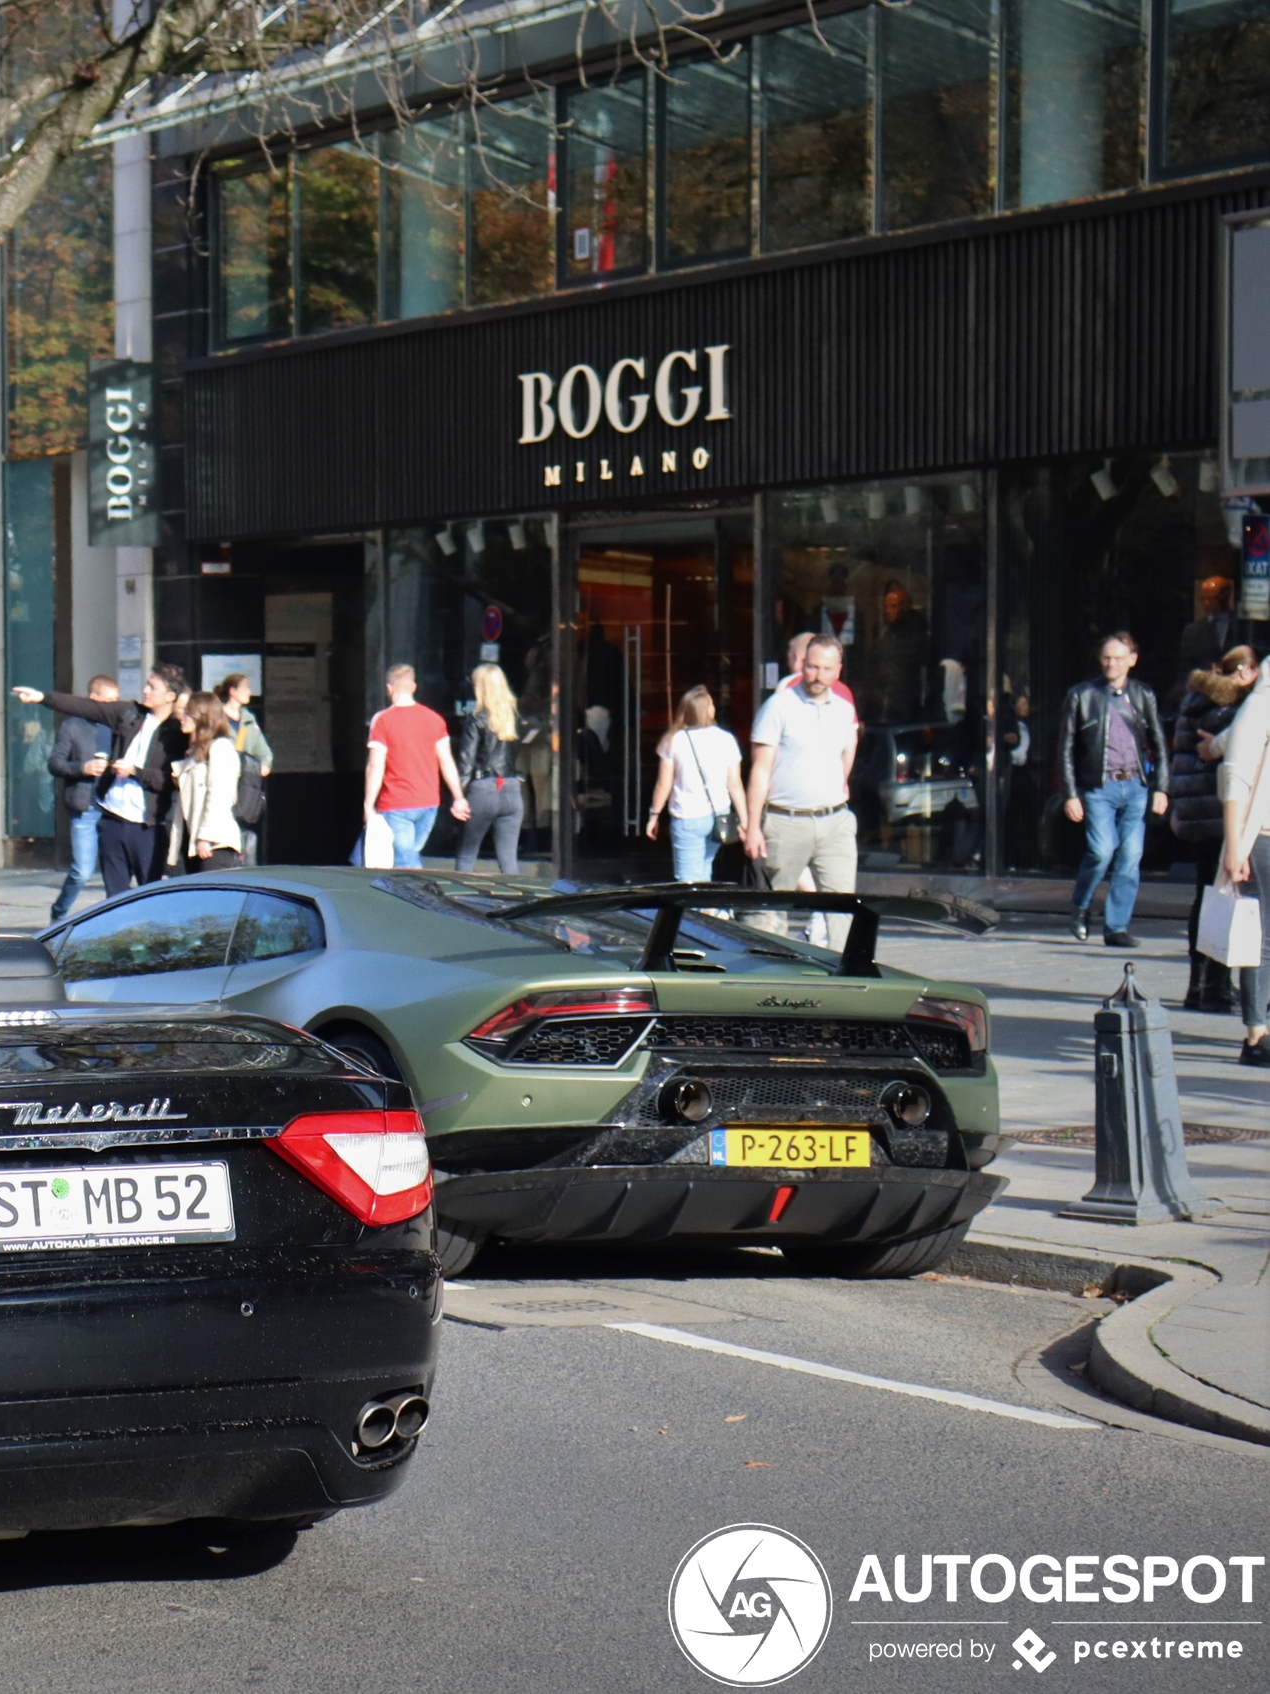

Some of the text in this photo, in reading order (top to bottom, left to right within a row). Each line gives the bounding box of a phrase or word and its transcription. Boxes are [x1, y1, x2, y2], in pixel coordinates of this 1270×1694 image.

[518, 344, 733, 444] BOGGI
[106, 388, 132, 520] BOGGI
[137, 402, 148, 506] MILANO
[544, 447, 709, 487] MILANO
[712, 1151, 725, 1161] NL
[741, 1134, 857, 1162] P-263-LF
[83, 1177, 142, 1225] MB
[155, 1174, 210, 1221] 52
